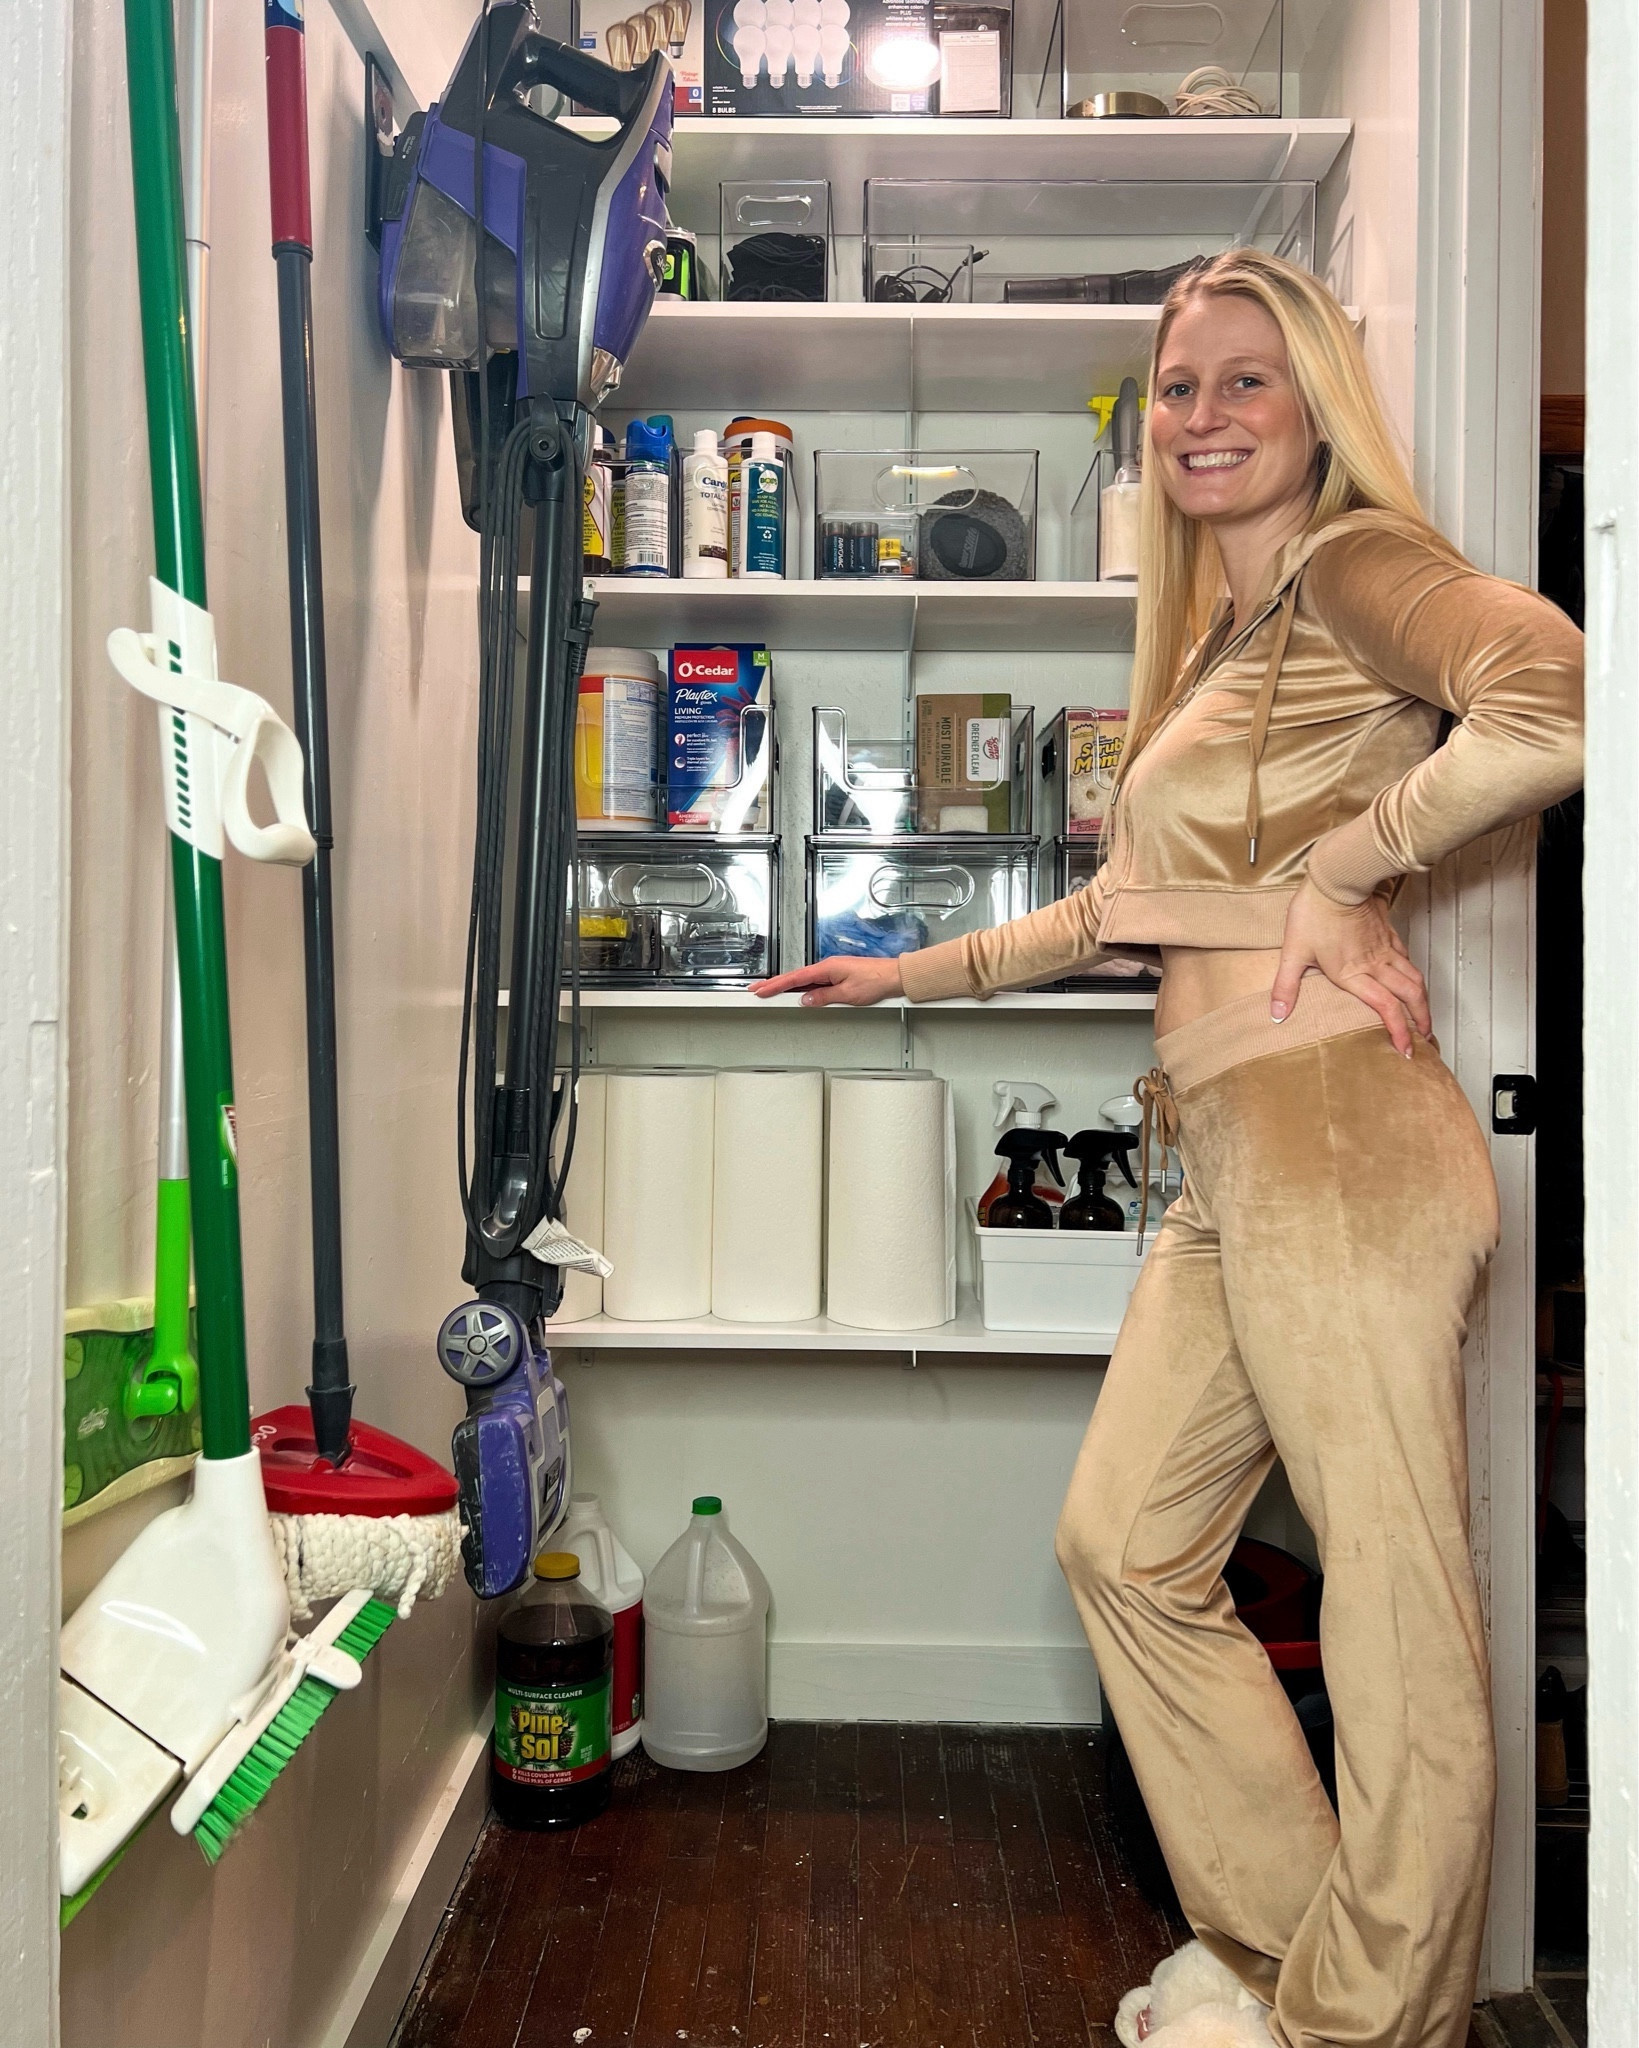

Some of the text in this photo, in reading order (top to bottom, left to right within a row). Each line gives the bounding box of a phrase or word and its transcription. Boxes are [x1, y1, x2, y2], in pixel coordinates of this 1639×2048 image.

[678, 661, 735, 678] O-Cedar
[675, 688, 718, 705] Playtex
[674, 707, 703, 715] LIVING
[941, 717, 951, 784] MOST DURABLE
[971, 723, 979, 775] GREENER CLEAN
[1081, 737, 1124, 758] Srub
[507, 1687, 583, 1700] MULTI-SURFACE CLEANER
[518, 1711, 569, 1735] Pine-
[521, 1733, 559, 1760] Sol
